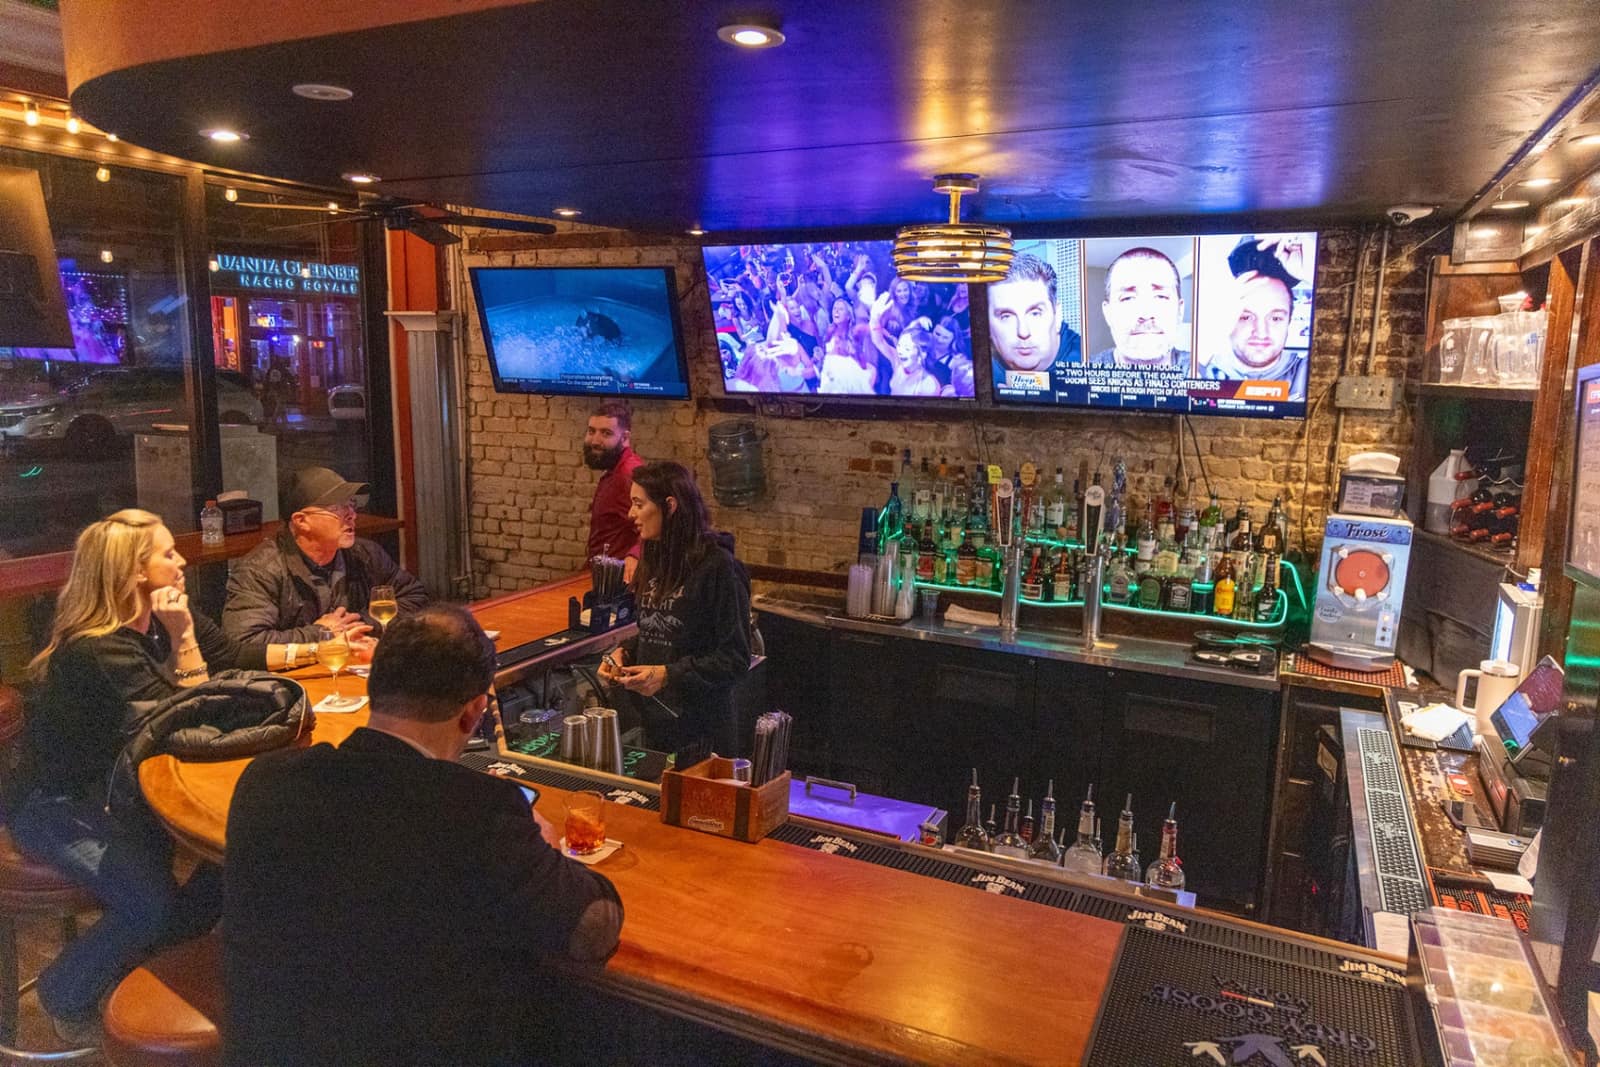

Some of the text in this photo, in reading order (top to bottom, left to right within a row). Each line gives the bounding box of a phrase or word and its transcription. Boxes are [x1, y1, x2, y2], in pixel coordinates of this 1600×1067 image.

[1065, 369, 1083, 377] TWO
[1084, 369, 1111, 378] HOURS
[1112, 370, 1142, 379] BEFORE
[1160, 372, 1185, 380] GAME
[1133, 379, 1144, 387] AS
[1145, 379, 1170, 388] FINALS
[1170, 380, 1221, 391] CONTENDERS
[1245, 386, 1282, 397] ESPN
[1346, 522, 1388, 538] Frosé
[1151, 981, 1376, 1052] GREY GOOSE
